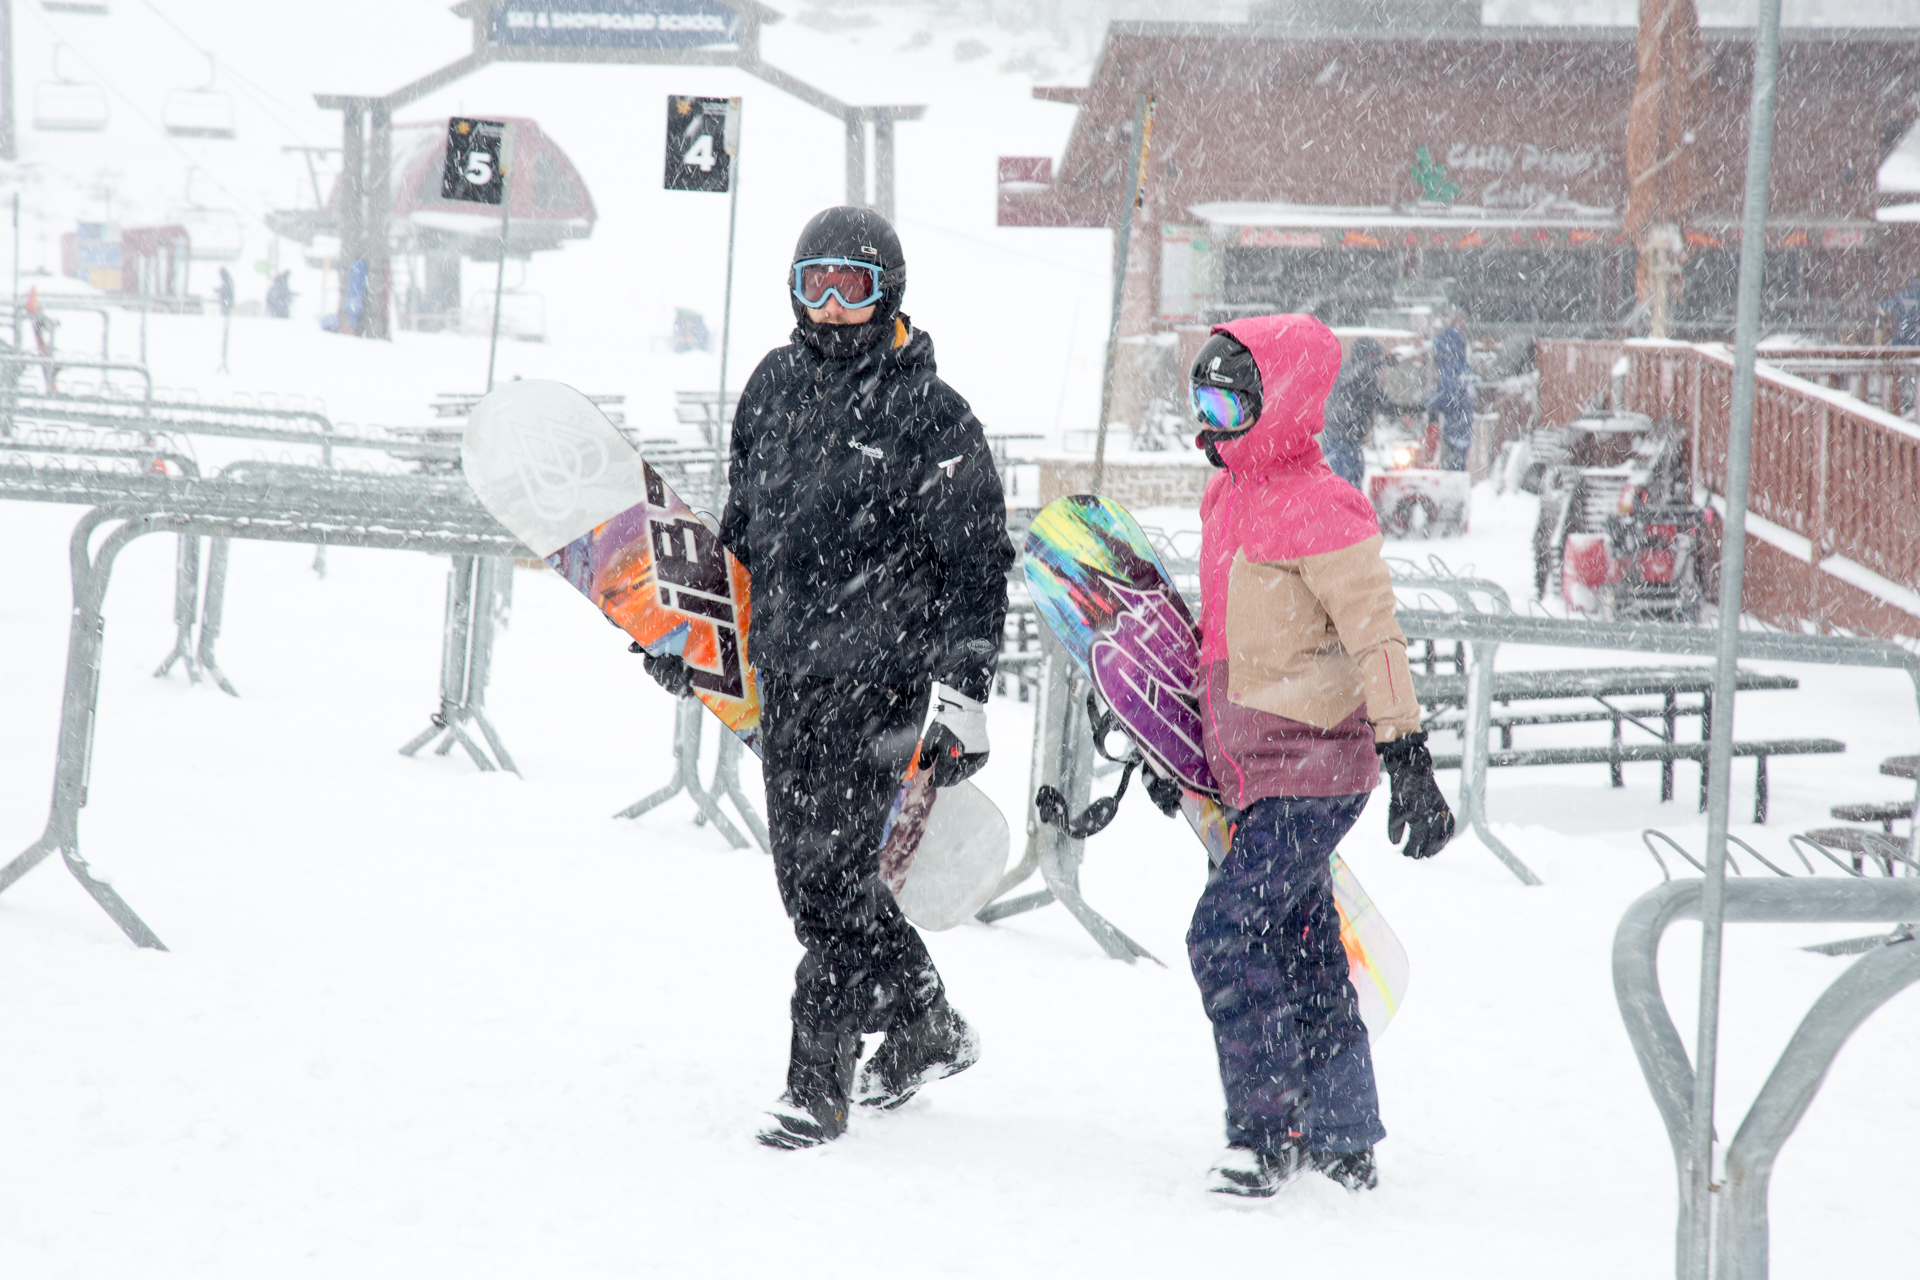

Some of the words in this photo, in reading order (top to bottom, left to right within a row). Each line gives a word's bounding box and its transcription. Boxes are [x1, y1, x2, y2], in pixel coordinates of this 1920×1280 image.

[551, 12, 657, 30] SNOWBOARD
[658, 14, 727, 32] SCHOOL
[465, 151, 493, 185] 5
[683, 134, 716, 172] 4
